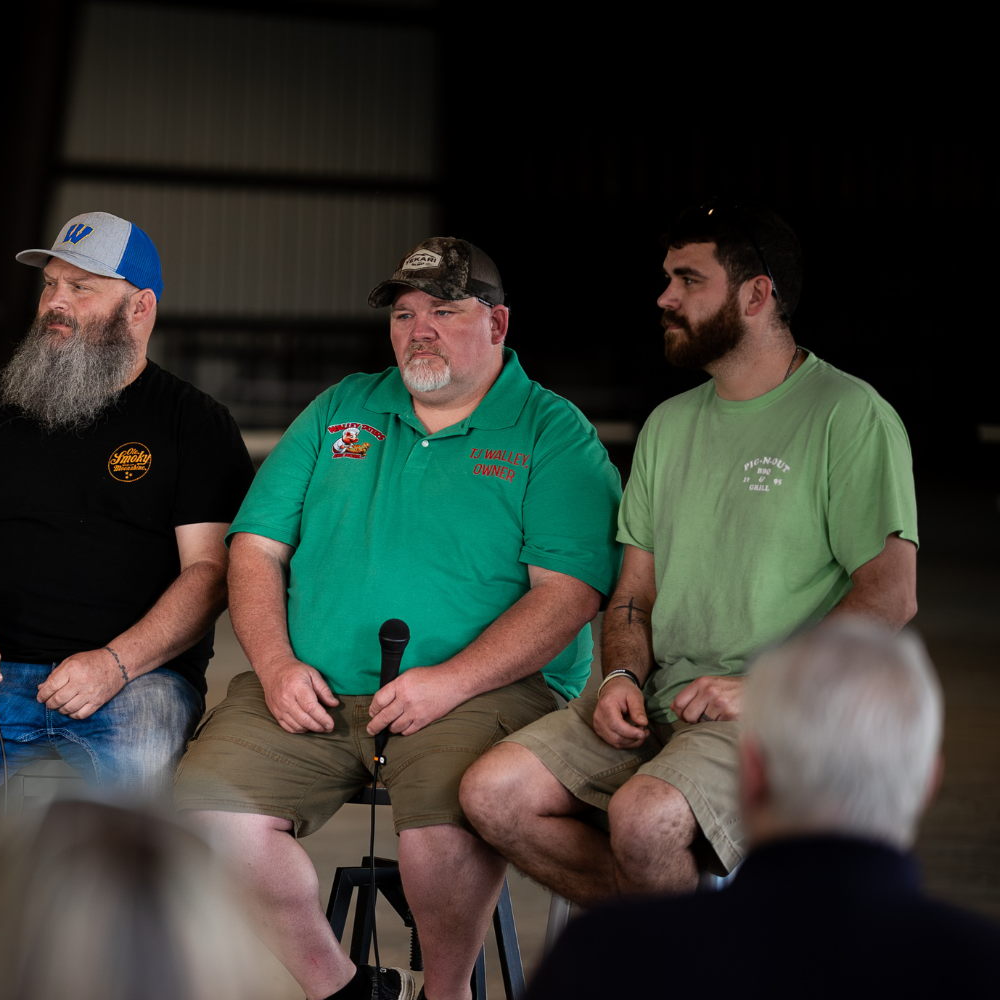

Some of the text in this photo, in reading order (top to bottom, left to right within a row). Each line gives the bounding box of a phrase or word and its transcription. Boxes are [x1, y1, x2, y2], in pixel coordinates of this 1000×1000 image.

[61, 222, 95, 246] W
[110, 450, 152, 465] Smoky
[470, 448, 530, 469] TJ WALLEY,
[473, 463, 516, 483] OWNER
[748, 484, 770, 492] GRILL
